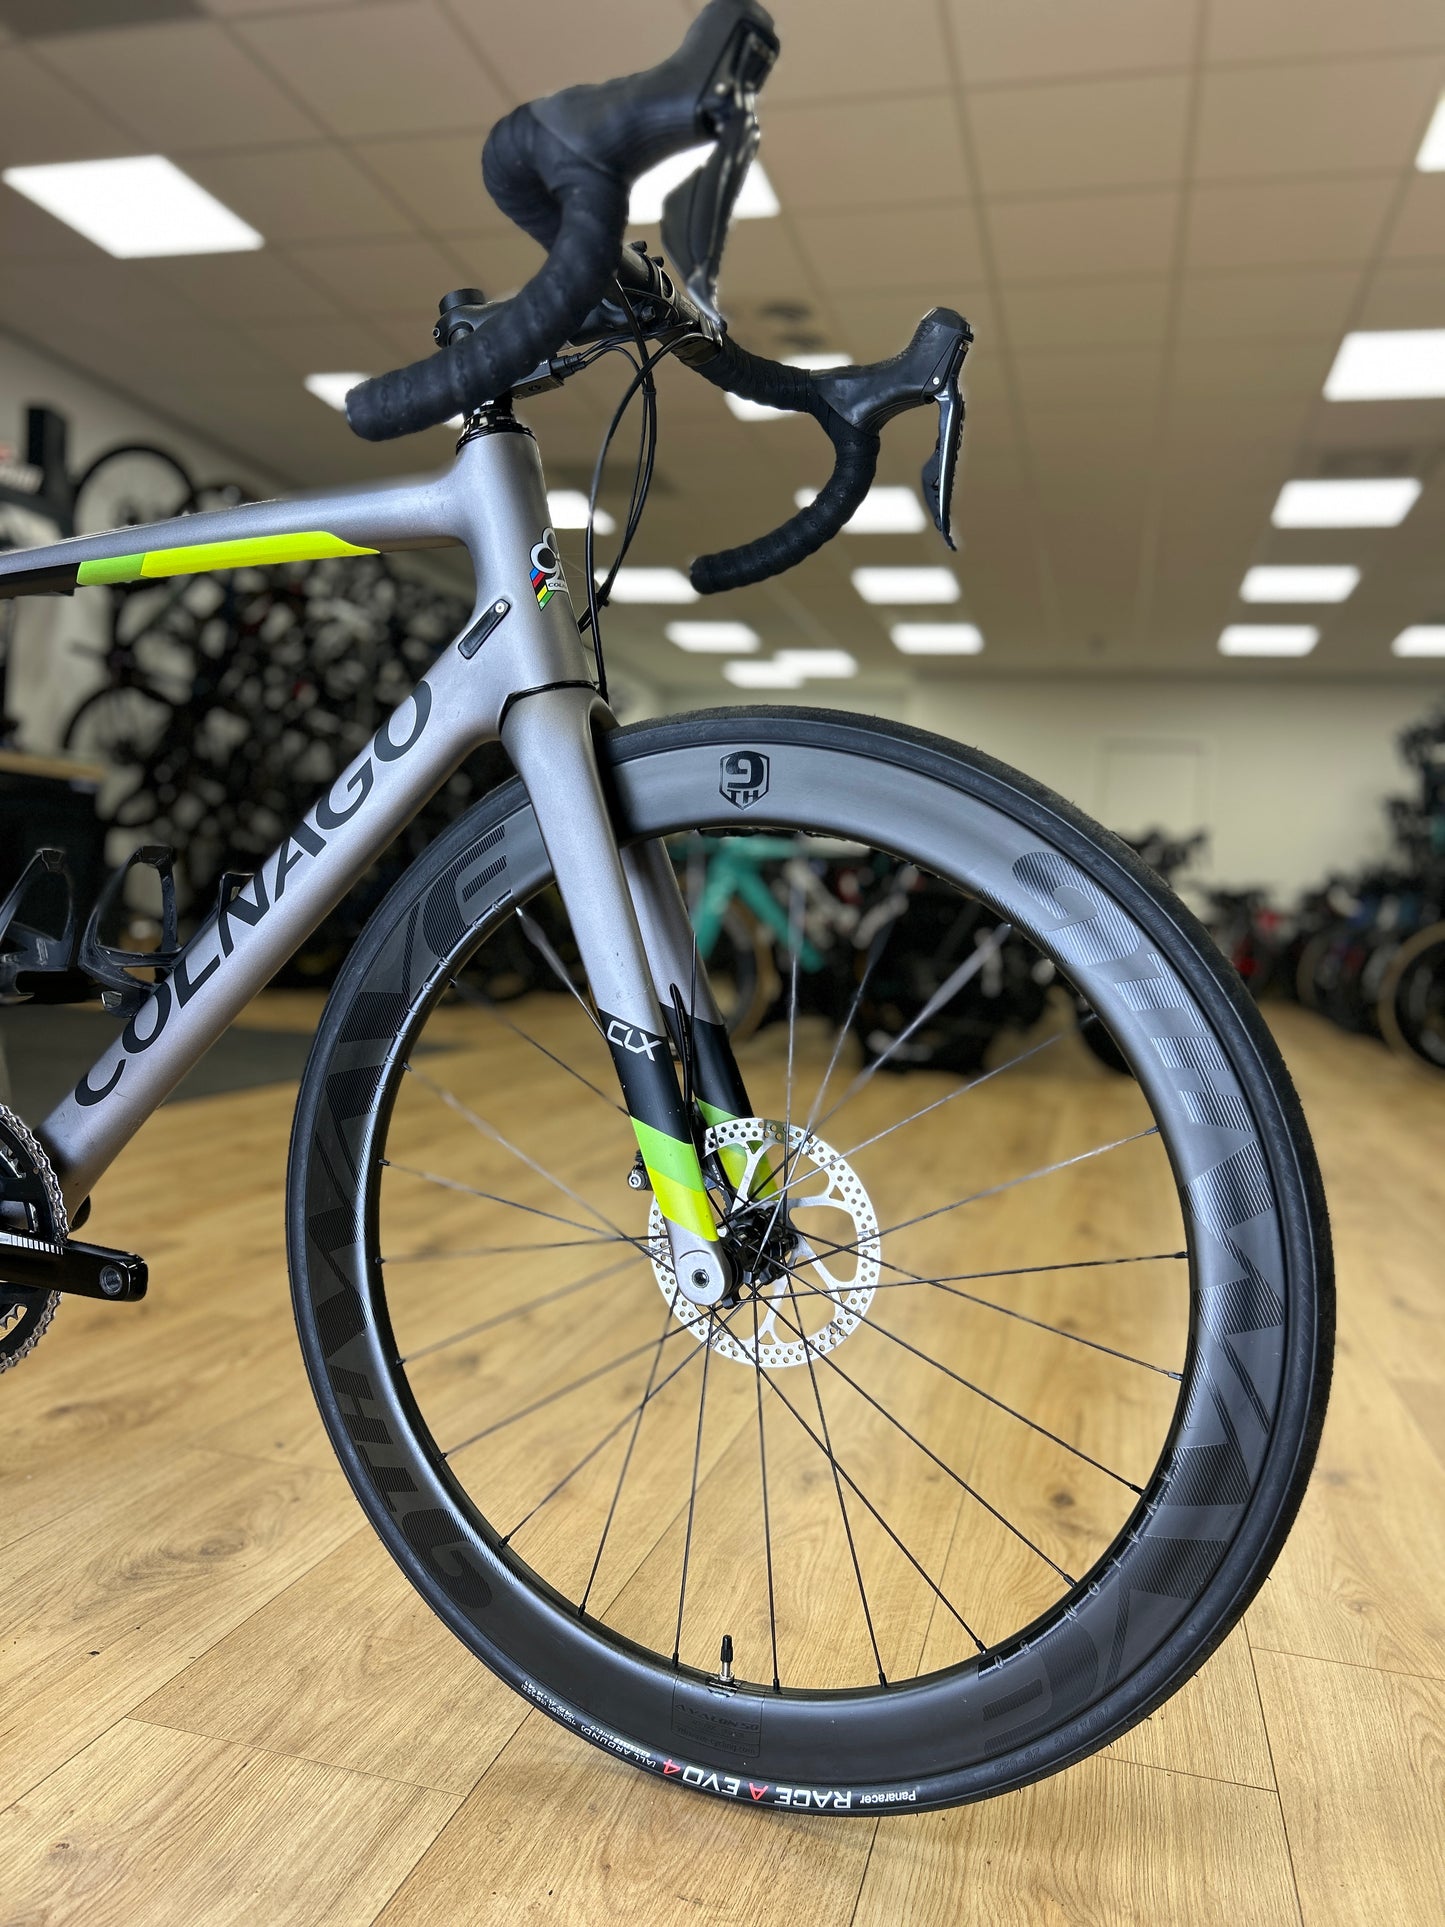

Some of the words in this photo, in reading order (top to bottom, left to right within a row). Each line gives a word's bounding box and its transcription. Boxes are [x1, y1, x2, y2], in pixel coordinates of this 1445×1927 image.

[75, 680, 432, 1107] COLNAGO
[748, 1782, 769, 1801] A
[773, 1786, 853, 1810] RACE
[859, 1789, 917, 1806] Panaracer
